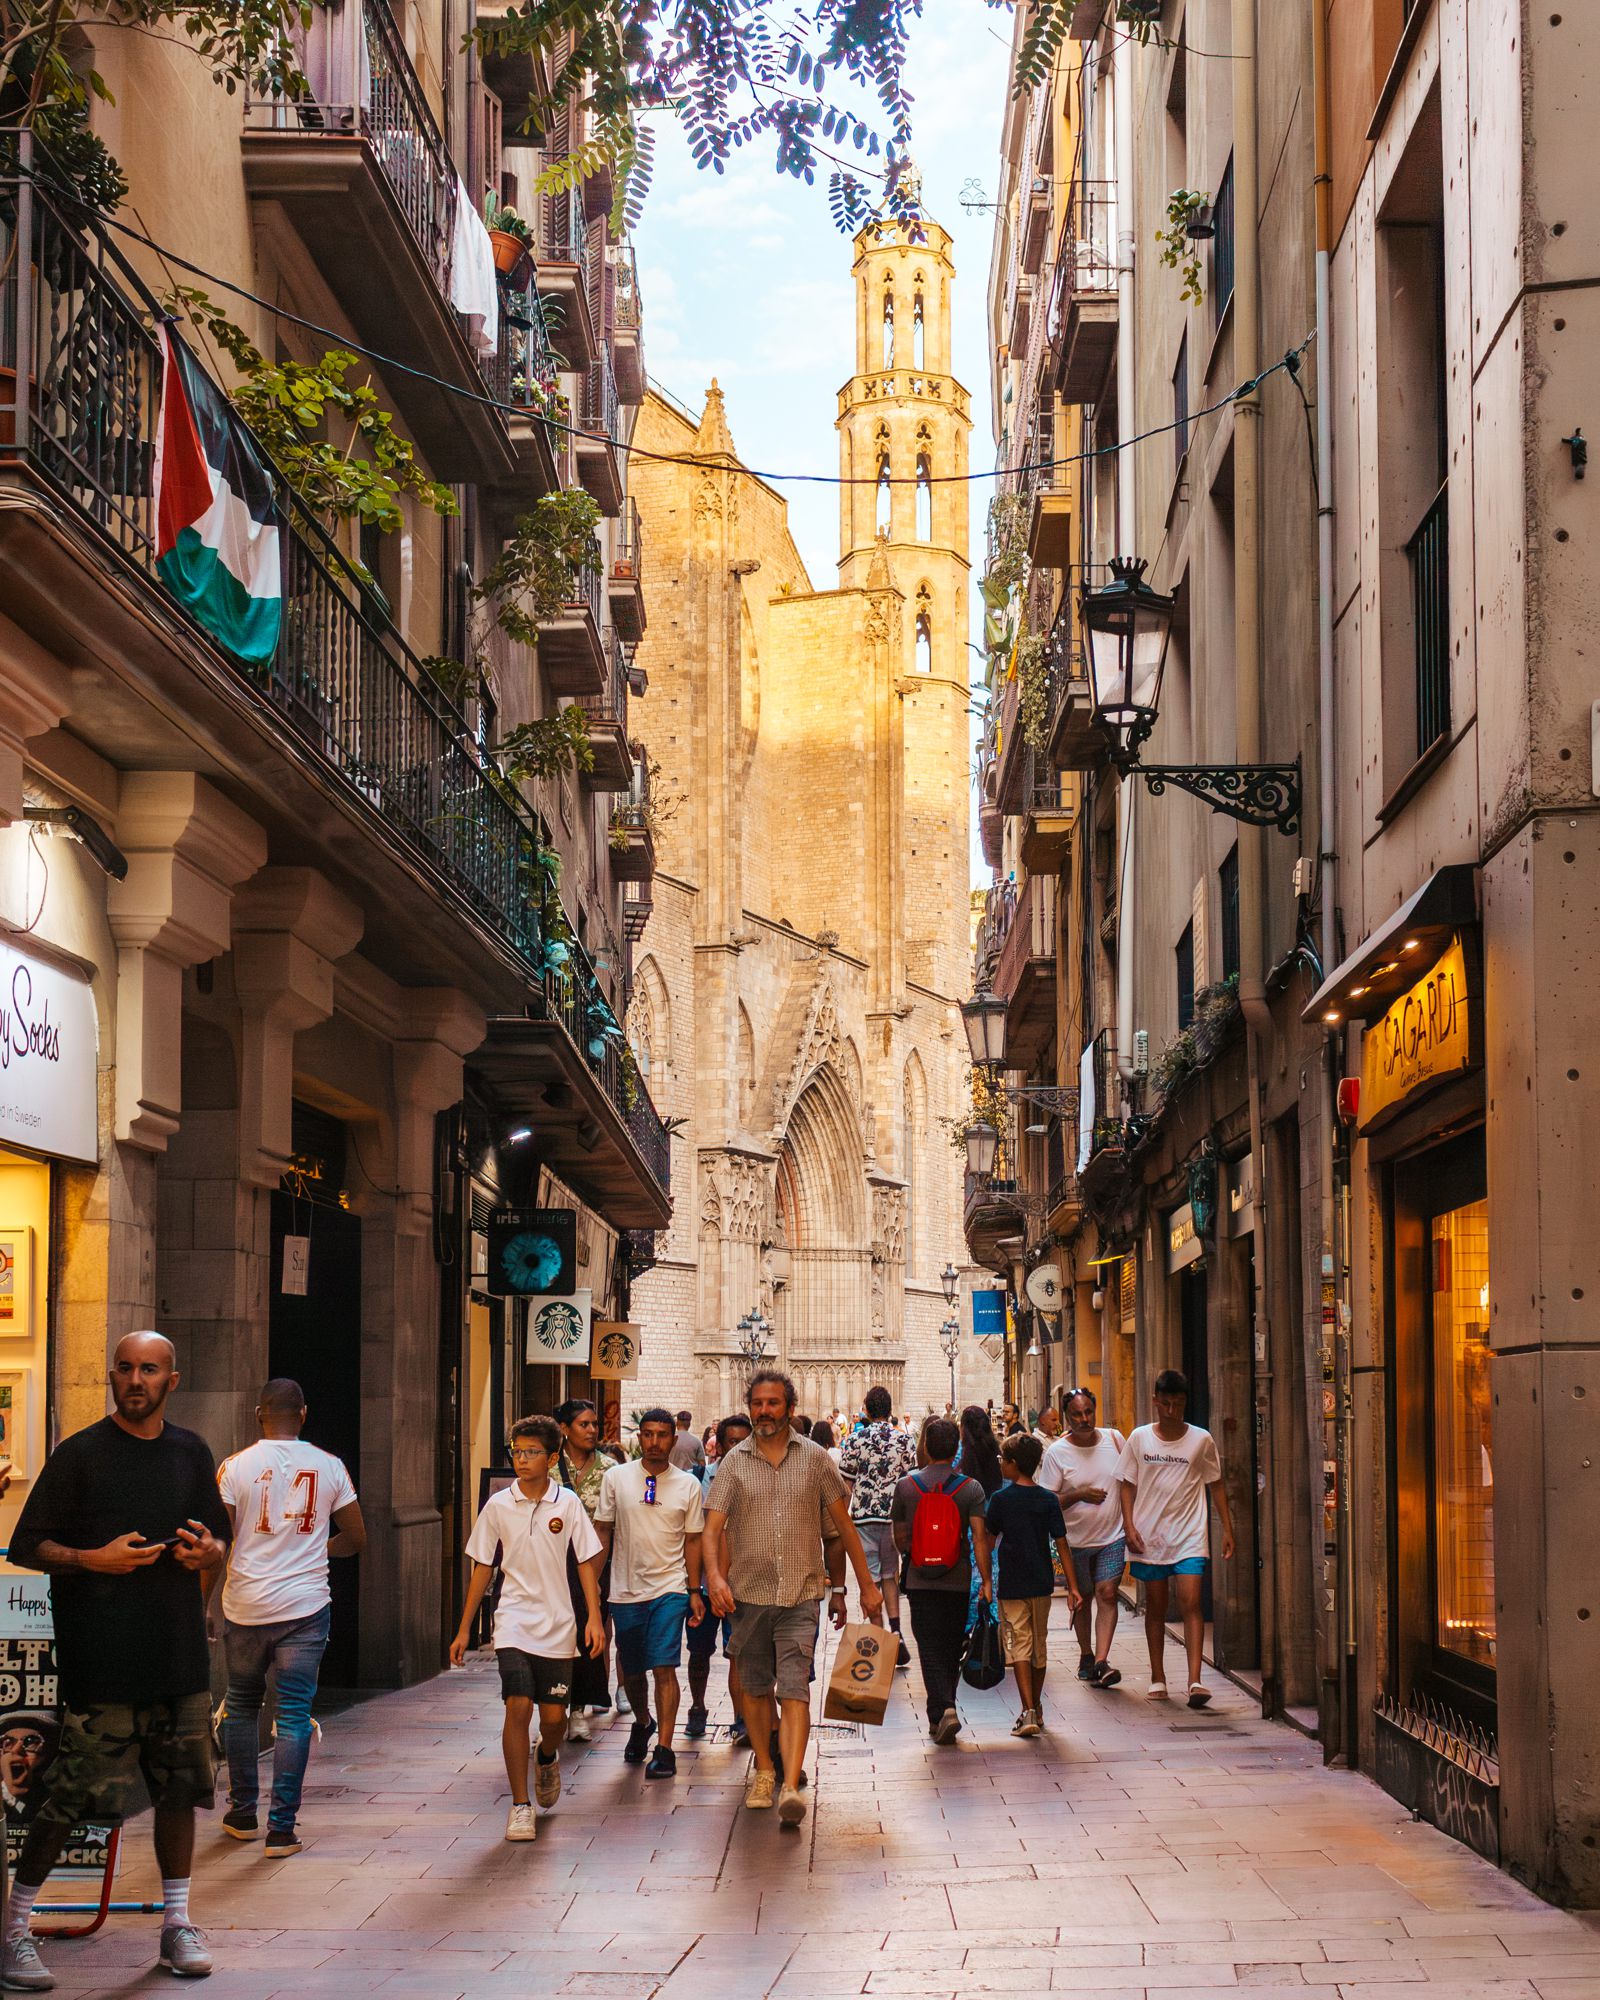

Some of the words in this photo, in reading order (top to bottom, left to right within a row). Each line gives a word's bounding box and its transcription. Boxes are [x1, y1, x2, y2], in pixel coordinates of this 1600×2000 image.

[12, 965, 60, 1063] Socks
[1383, 972, 1457, 1078] SAGARDI
[15, 1106, 42, 1129] Sweden
[496, 1211, 521, 1225] iris
[255, 1468, 318, 1535] 14
[8, 1585, 47, 1616] Happy
